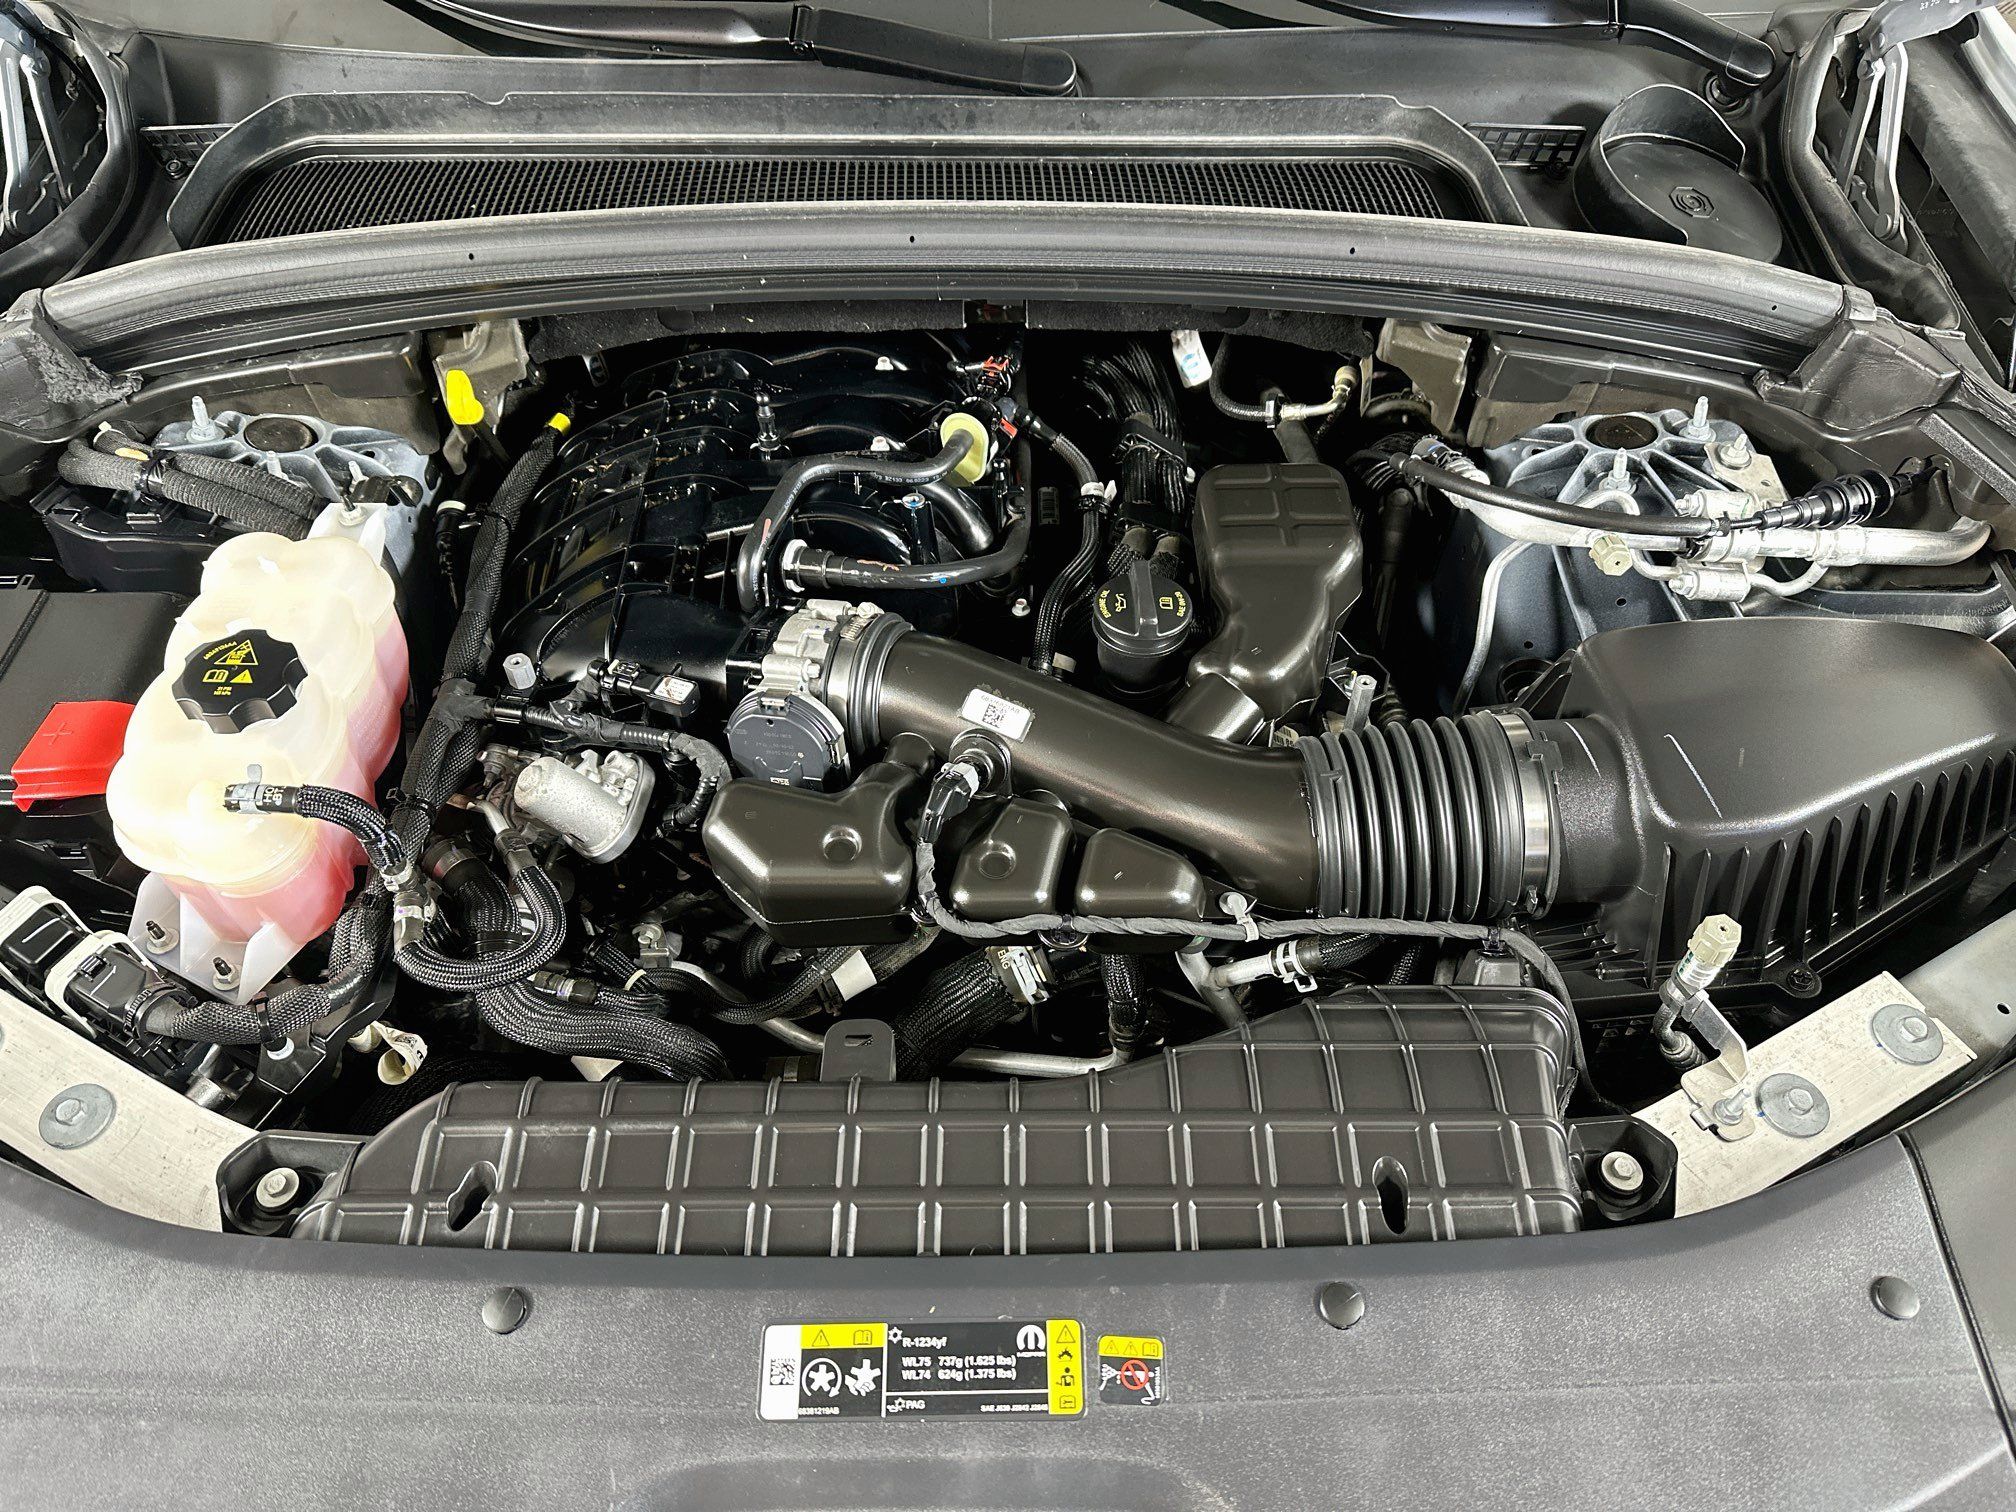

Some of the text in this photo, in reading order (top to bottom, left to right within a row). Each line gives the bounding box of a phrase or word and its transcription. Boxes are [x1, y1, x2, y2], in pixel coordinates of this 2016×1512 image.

[1098, 589, 1111, 618] ENGINE OIL
[997, 949, 1010, 969] ENG
[902, 1337, 947, 1349] R-1234yf
[902, 1355, 1017, 1368] WL75 737g (1.625 lbs)
[902, 1368, 1017, 1381] WL74 624g (1.375 lbs)
[905, 1400, 926, 1409] PAG
